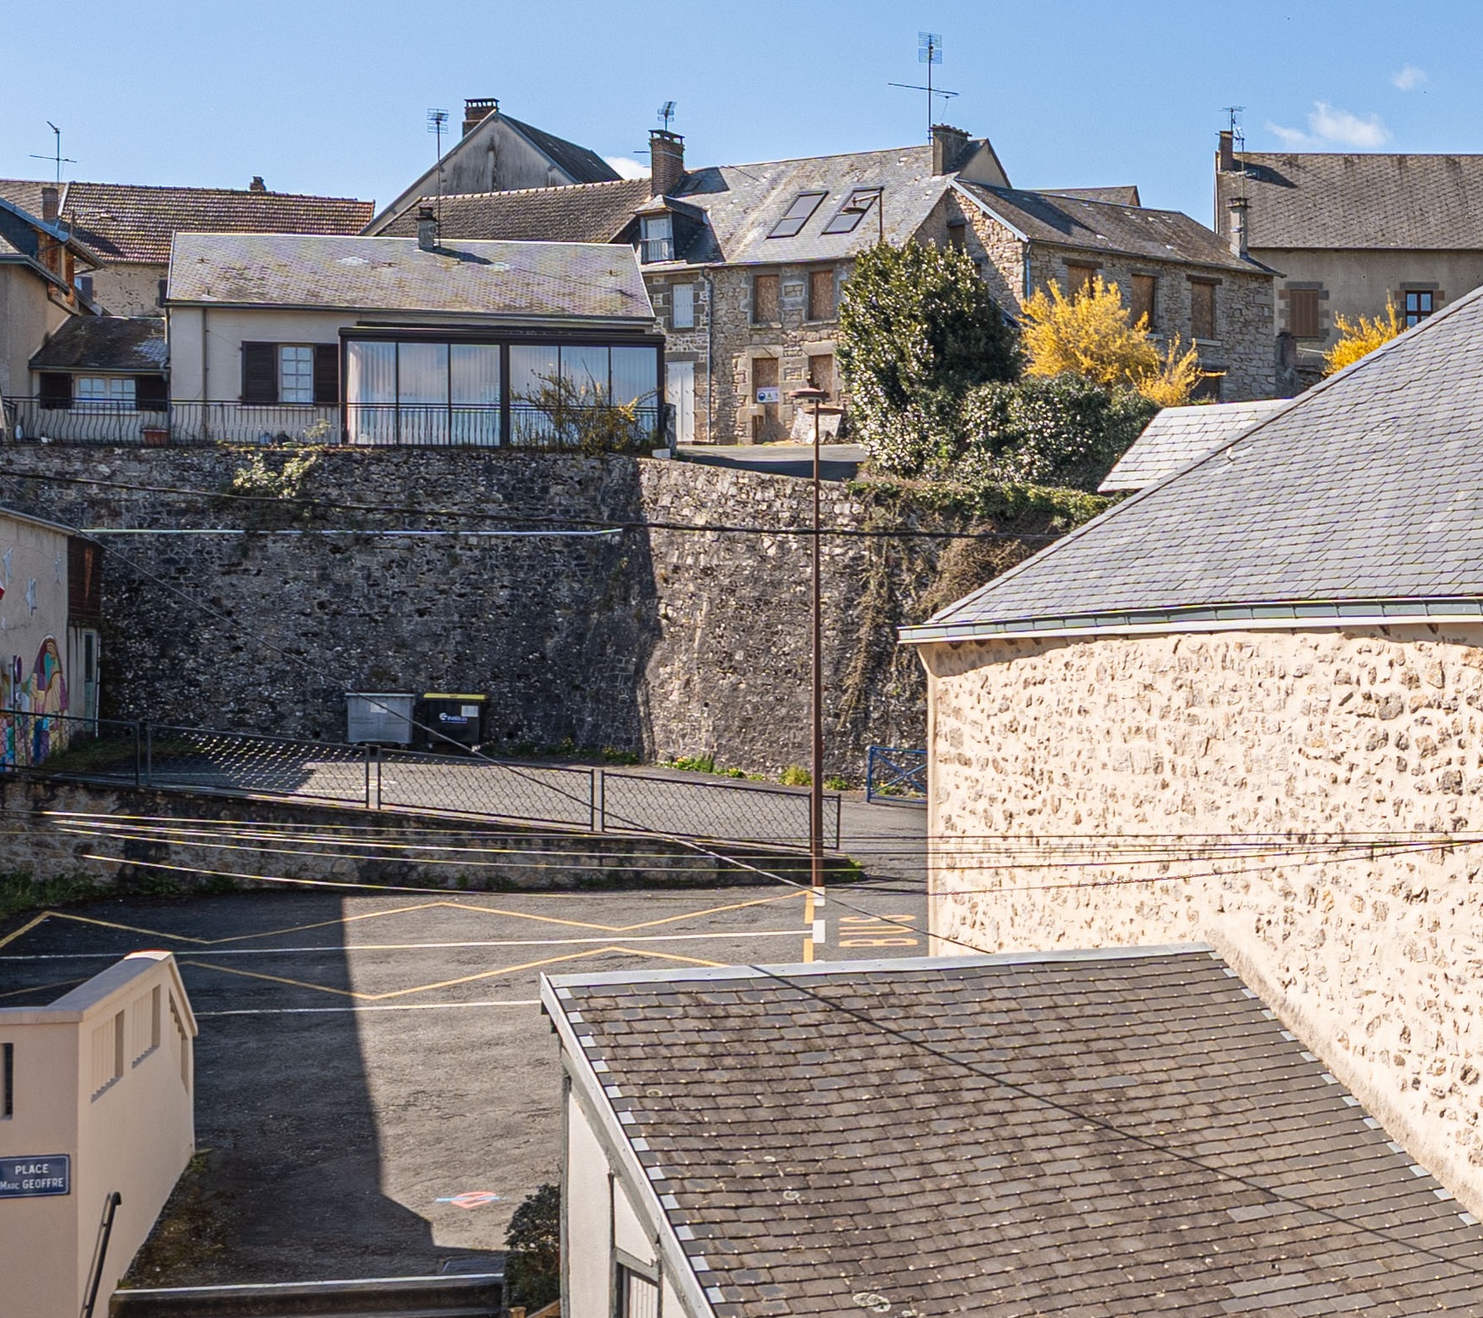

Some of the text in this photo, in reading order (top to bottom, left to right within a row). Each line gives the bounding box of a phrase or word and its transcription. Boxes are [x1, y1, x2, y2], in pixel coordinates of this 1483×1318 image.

[839, 915, 918, 947] BUS
[15, 1164, 49, 1175] PLACE
[22, 1177, 64, 1190] GEOFFRE
